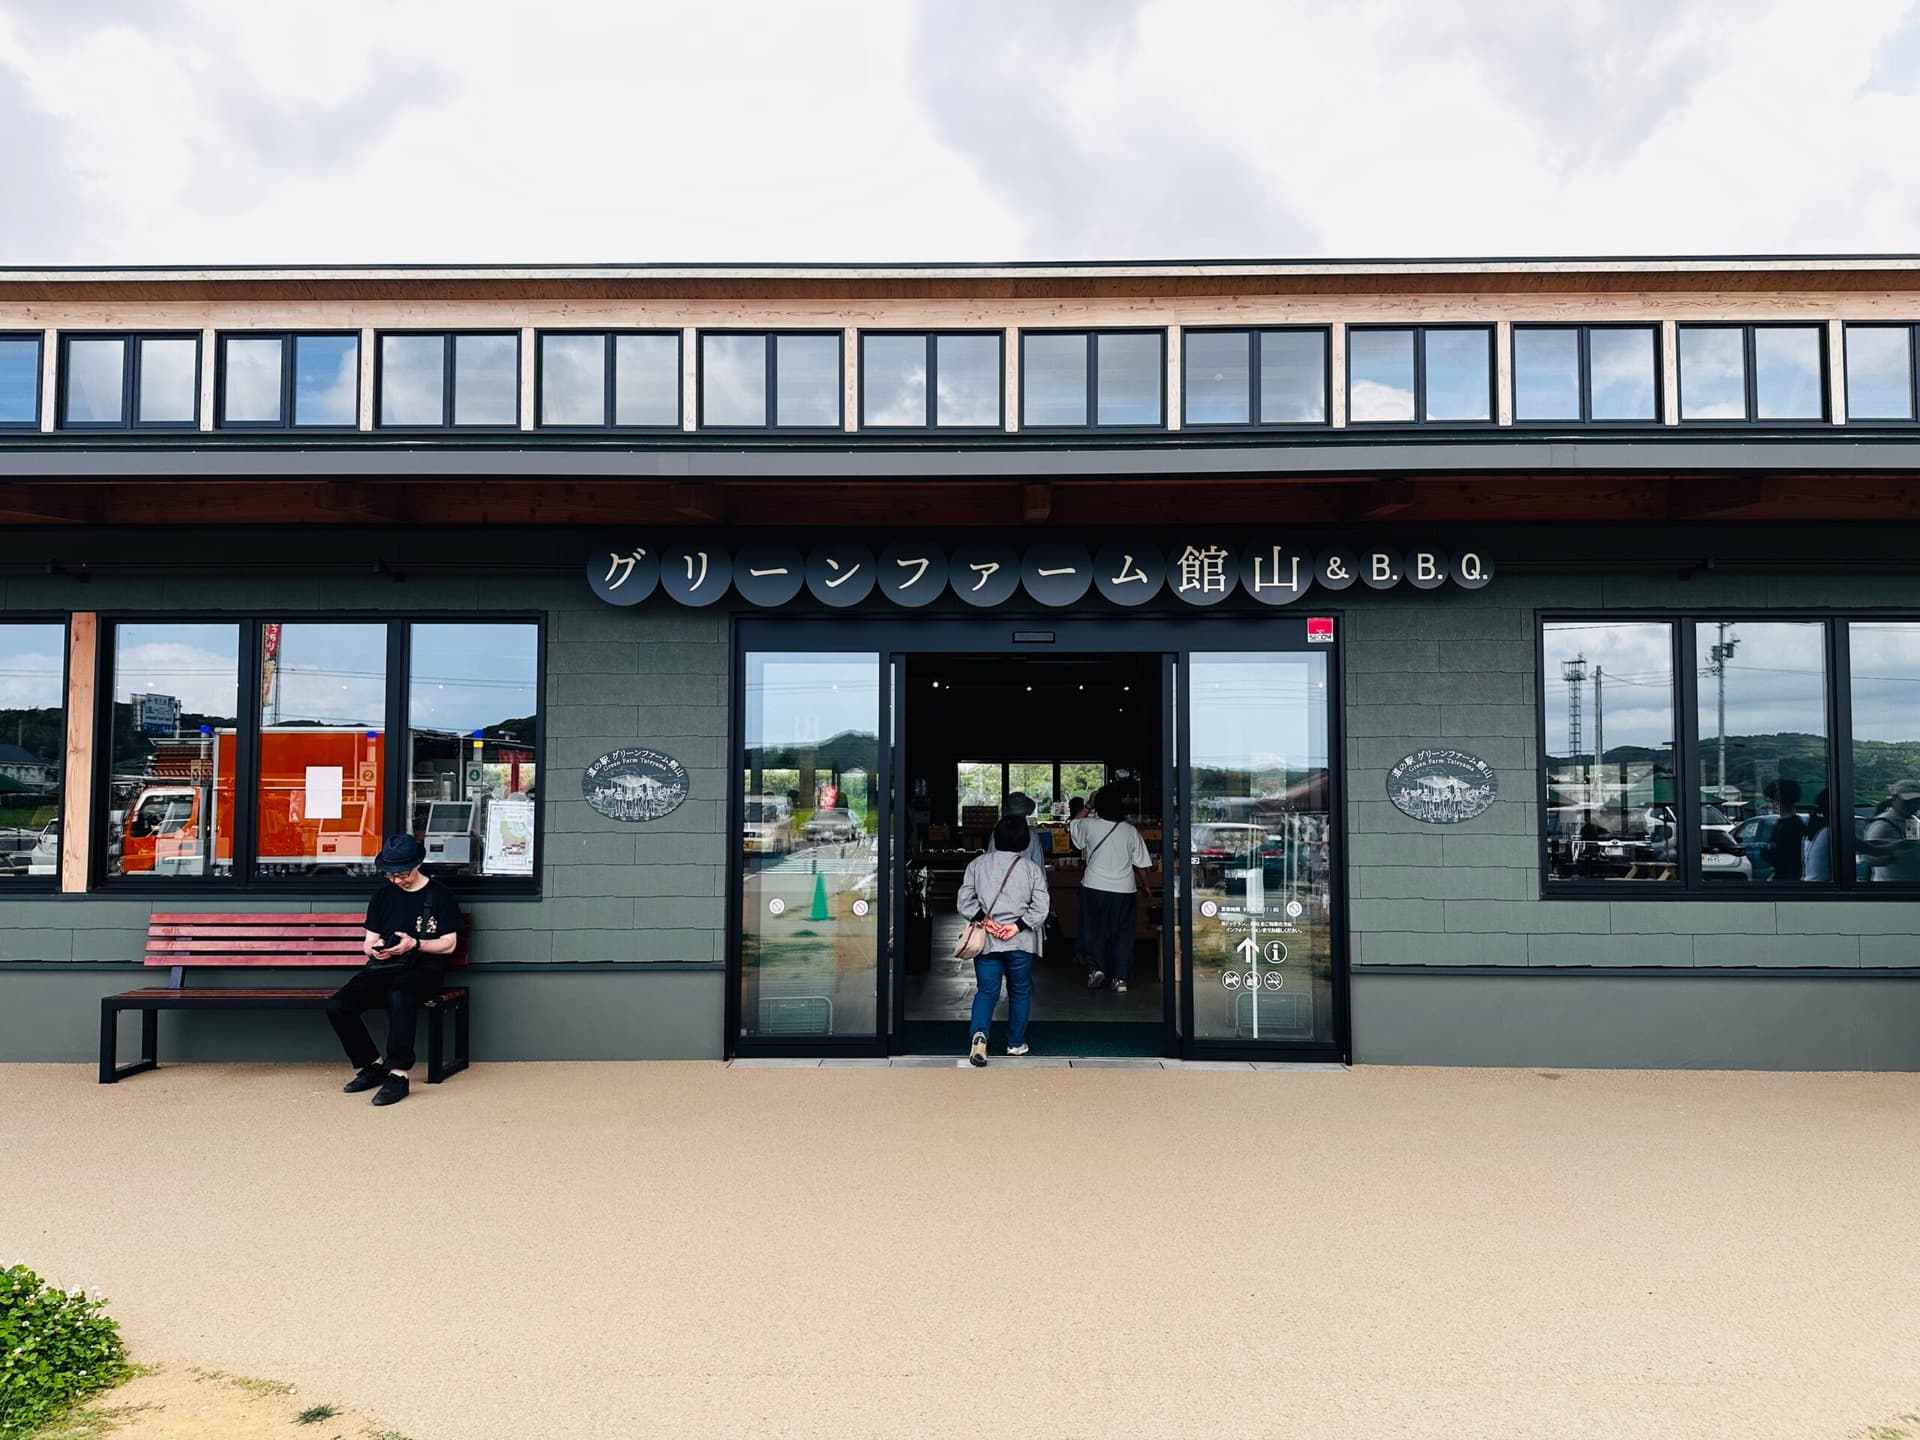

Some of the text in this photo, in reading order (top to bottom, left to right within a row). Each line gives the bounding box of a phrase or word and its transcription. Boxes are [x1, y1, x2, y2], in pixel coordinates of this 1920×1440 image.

[604, 545, 1300, 593] グリーンファーム館山
[1326, 557, 1350, 580] &
